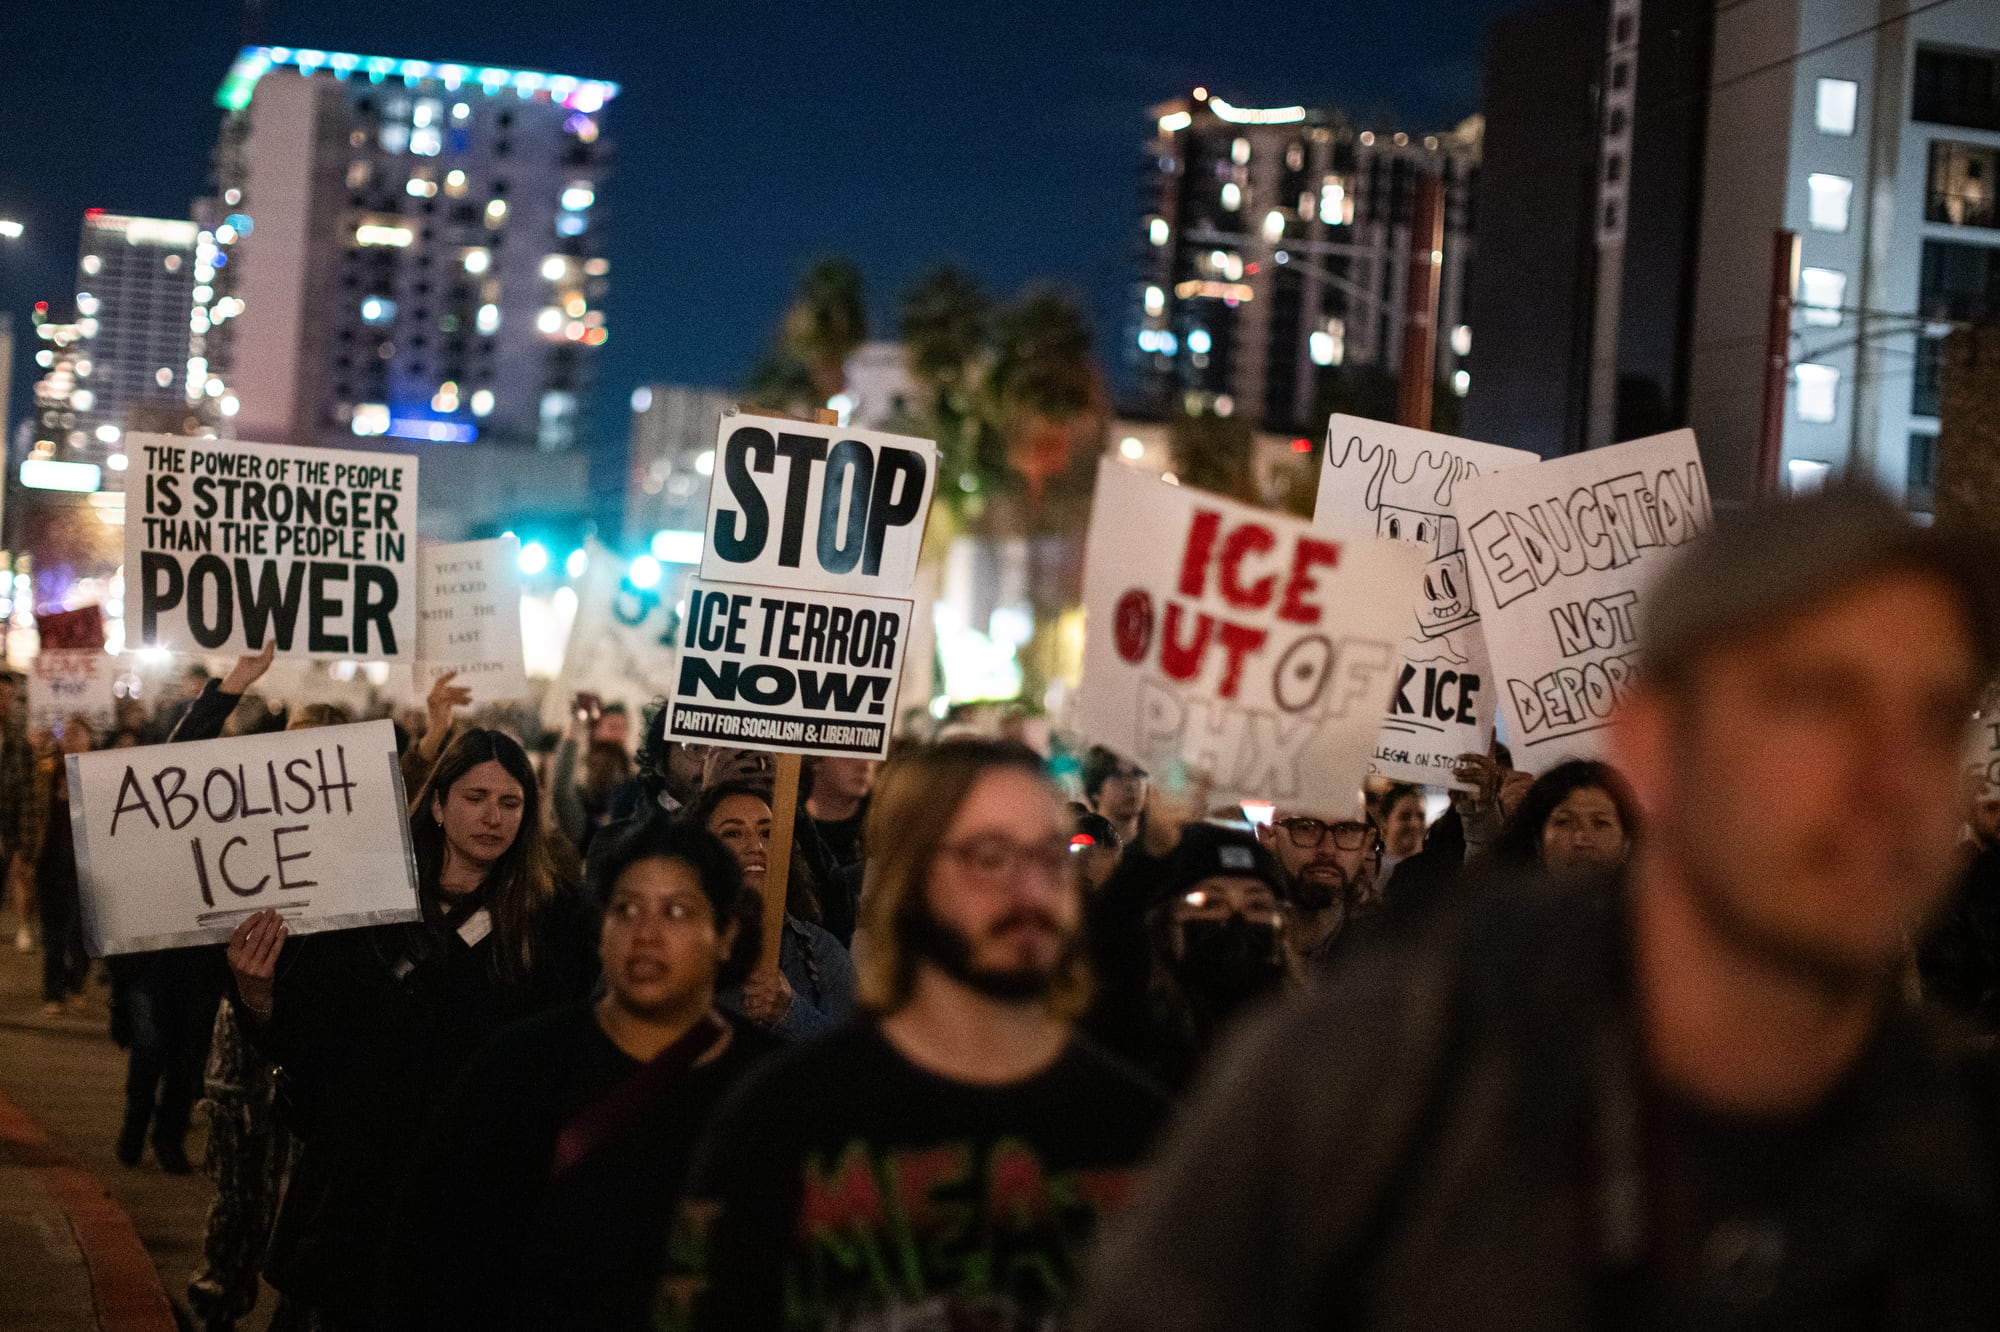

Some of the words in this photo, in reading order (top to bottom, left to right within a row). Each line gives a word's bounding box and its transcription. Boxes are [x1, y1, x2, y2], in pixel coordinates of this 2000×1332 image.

[143, 446, 186, 472] THE
[190, 451, 261, 480] POWER
[266, 457, 290, 481] OF
[294, 460, 329, 486] THE
[335, 464, 402, 491] PEOPLE
[146, 474, 182, 517] IS
[192, 477, 399, 531] STRONGER
[713, 426, 927, 577] STOP
[142, 517, 212, 555] THAN
[218, 521, 268, 556] THE
[275, 525, 366, 560] PEOPLE
[376, 532, 405, 563] IN
[1178, 509, 1344, 625] ICE
[140, 551, 399, 655] POWER
[685, 589, 753, 654] ICE
[760, 597, 901, 670] TERROR
[1550, 590, 1638, 658] NOT
[677, 656, 892, 715] NOW!
[1113, 587, 1269, 700] OUT
[1273, 634, 1398, 721] OF
[675, 709, 716, 732] PARTY
[716, 715, 741, 734] FOR
[741, 718, 804, 741] SOCIALISM
[804, 723, 819, 743] &
[819, 725, 881, 747] LIBERATION
[1423, 668, 1480, 726] ICE
[1507, 650, 1643, 734] DEPOR
[110, 744, 357, 836] ABOLISH
[1371, 746, 1411, 764] LEGAL
[1415, 752, 1430, 766] ON
[191, 825, 318, 908] ICE
